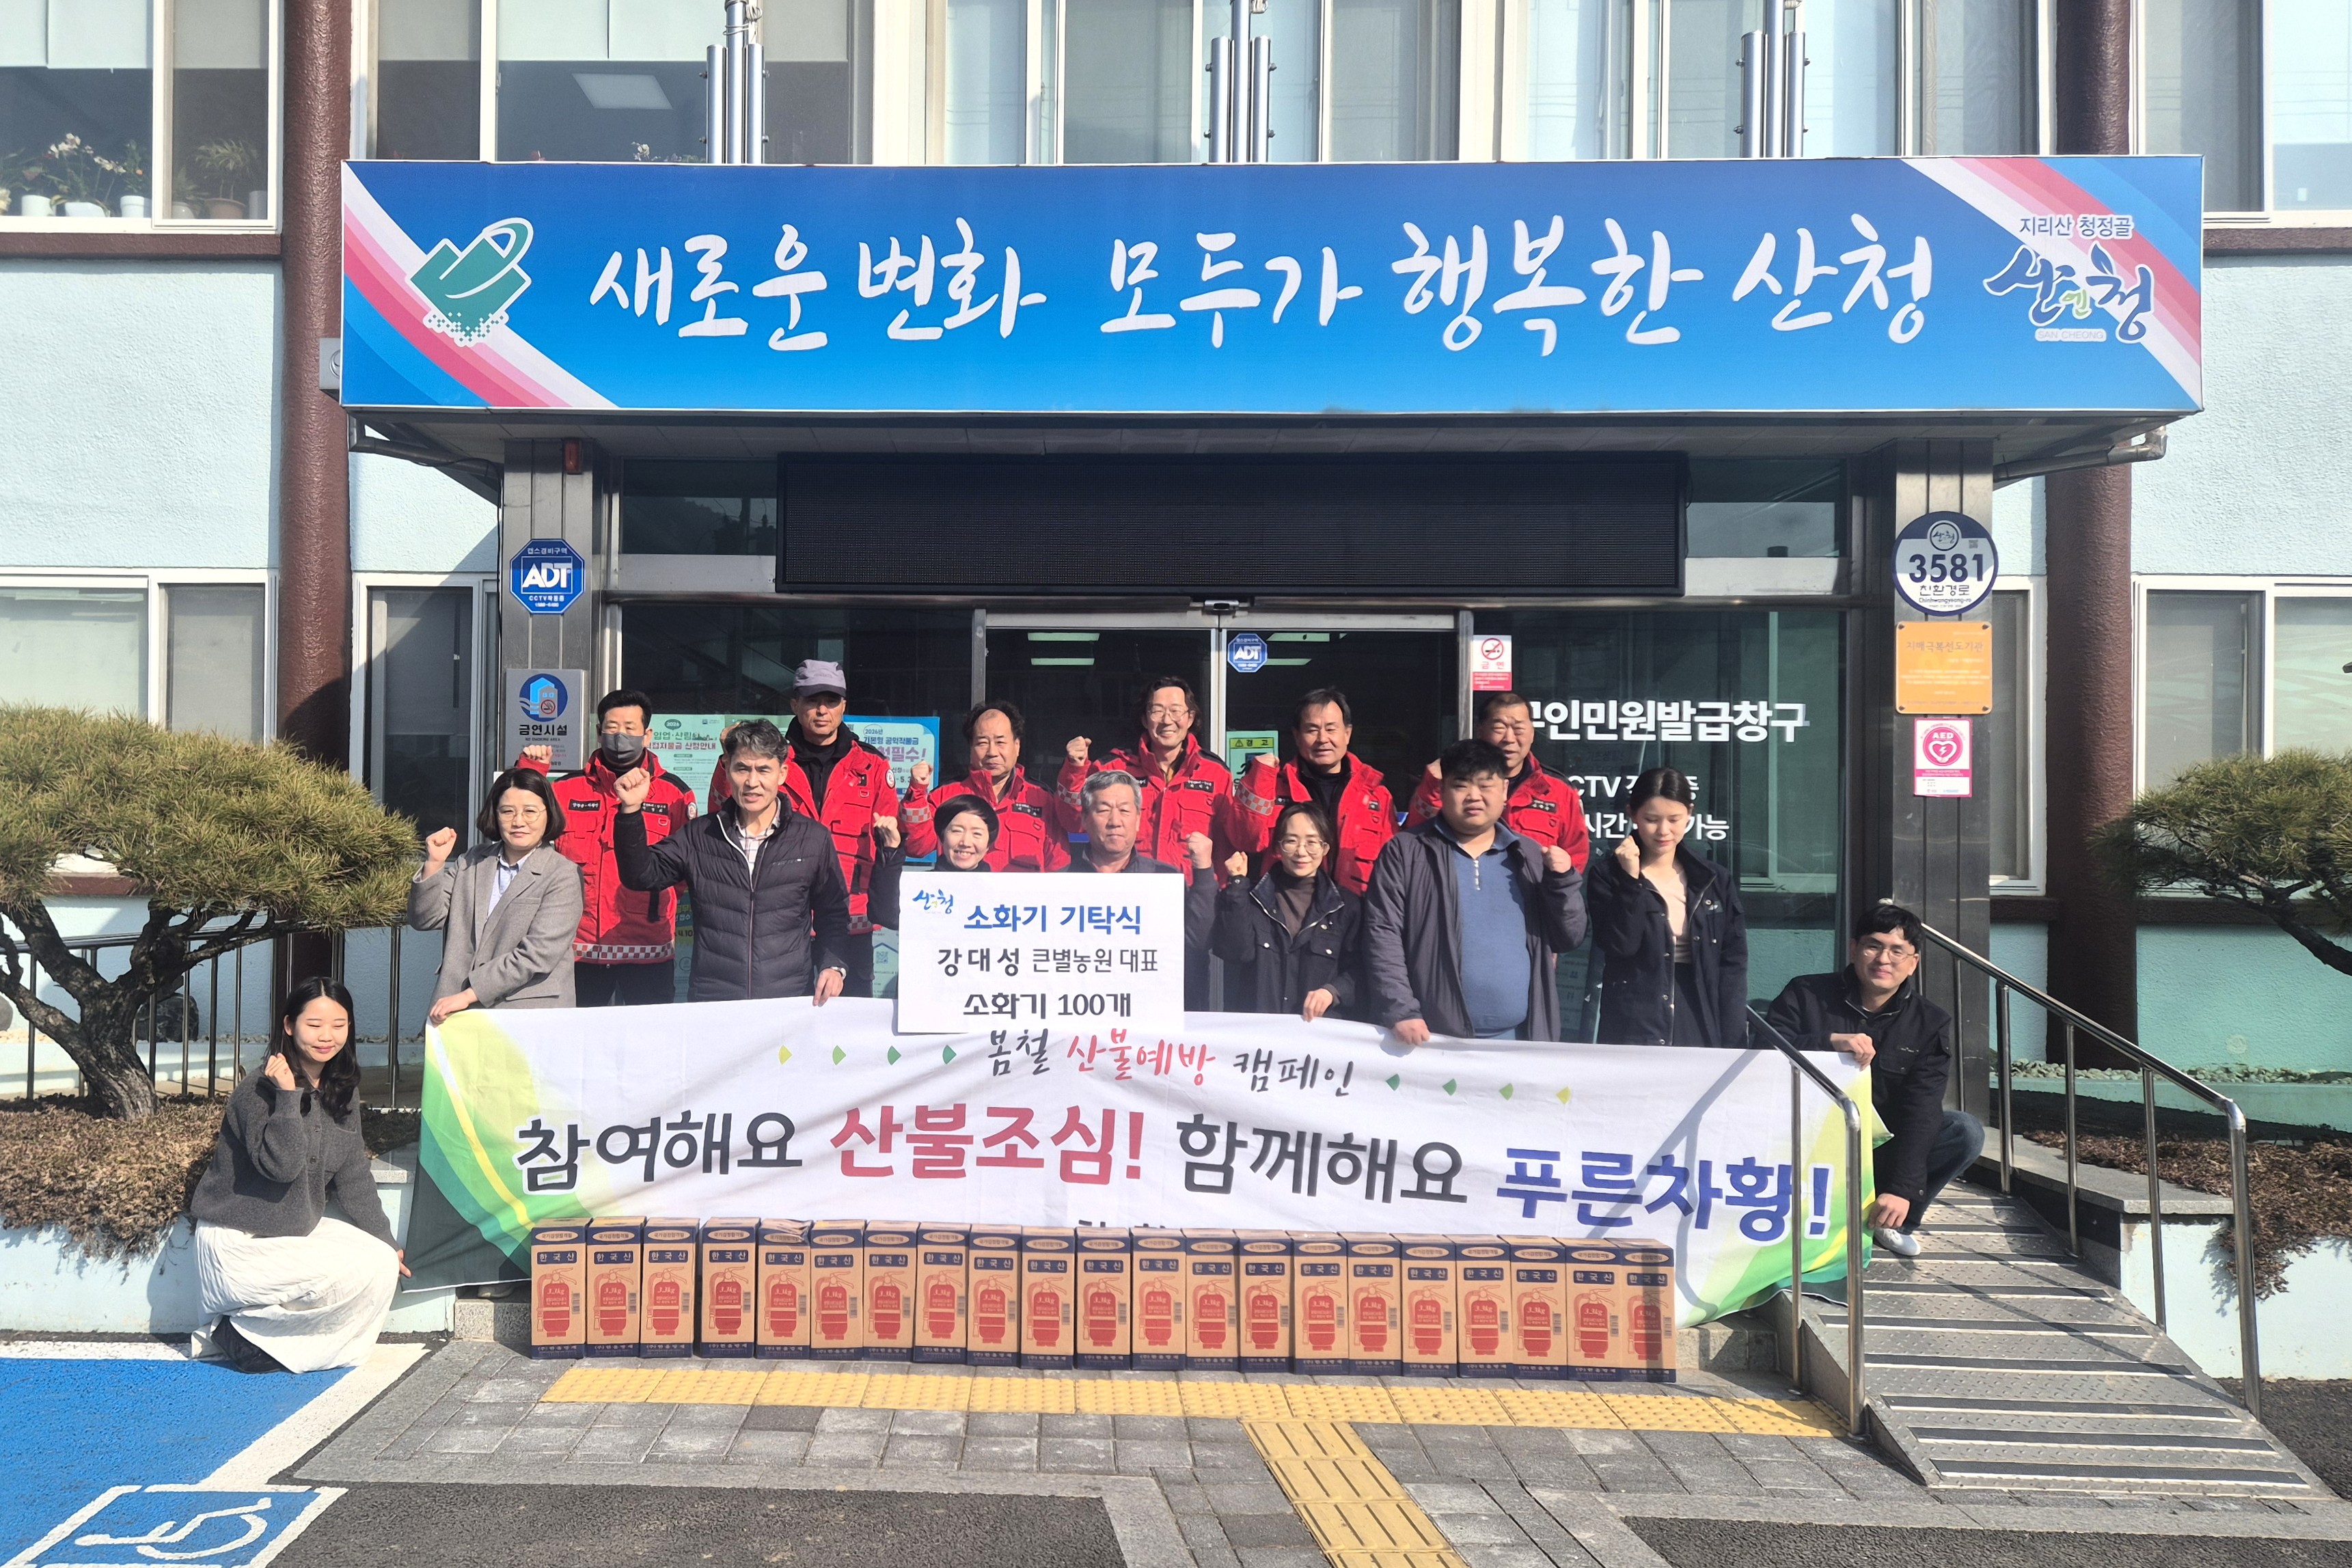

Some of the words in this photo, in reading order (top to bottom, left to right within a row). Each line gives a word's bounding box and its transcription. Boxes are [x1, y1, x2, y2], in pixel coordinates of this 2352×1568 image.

[2019, 216, 2073, 237] 지리산
[2079, 216, 2132, 237] 청정골
[589, 223, 828, 350] 새로운
[859, 217, 1047, 342] 변화
[1099, 231, 1363, 349] 모두가
[1391, 214, 1705, 357] 행복한
[1732, 213, 1932, 344] 산청
[2038, 331, 2058, 340] SAN
[2061, 331, 2104, 340] CHEONG
[1909, 553, 1984, 583] 3581
[522, 562, 572, 588] ADT
[1919, 585, 1970, 596] 친환경로
[1234, 646, 1261, 660] ADT
[519, 724, 568, 736] 금연시설
[685, 742, 716, 750] 신청안내
[864, 737, 884, 745] 기본형
[1568, 775, 1622, 798] CTV
[1585, 812, 1628, 839] 시간
[964, 904, 1046, 933] 소화기
[1060, 905, 1140, 935] 기탁식
[1033, 948, 1112, 974] 큰별농원
[1119, 948, 1158, 973] 대표
[963, 992, 1046, 1019] 소화기
[1058, 993, 1132, 1018] 100개
[989, 1028, 1050, 1076] 봄철
[1067, 1028, 1216, 1086] 산불예방
[1233, 1048, 1354, 1097] 캠페인
[517, 1109, 803, 1192] 참여해요
[830, 1103, 1145, 1186] 산불조심!
[1177, 1112, 1468, 1204] 함께해요
[1496, 1148, 1833, 1242] 푸른차황!
[540, 1253, 575, 1261] 한국산
[597, 1253, 631, 1261] 한국산
[651, 1252, 686, 1261] 한국산
[711, 1252, 746, 1261] 한국산
[767, 1253, 802, 1263] 한국산
[817, 1256, 851, 1265] 한국산
[871, 1256, 905, 1265] 한국산
[926, 1254, 961, 1263] 한국산
[976, 1258, 1011, 1268] 한국산
[1030, 1261, 1065, 1271] 한국산
[1086, 1261, 1121, 1271] 한국산
[1141, 1260, 1177, 1269] 한국산
[1195, 1264, 1230, 1274] 한국산
[1248, 1264, 1282, 1274] 한국산
[1303, 1265, 1338, 1274] 한국산
[1356, 1266, 1391, 1275] 한국산
[1410, 1269, 1446, 1278] 한국산
[1466, 1269, 1501, 1278] 한국산
[1519, 1271, 1555, 1280] 한국산
[1576, 1272, 1612, 1282] 한국산
[1629, 1275, 1665, 1284] 한국산
